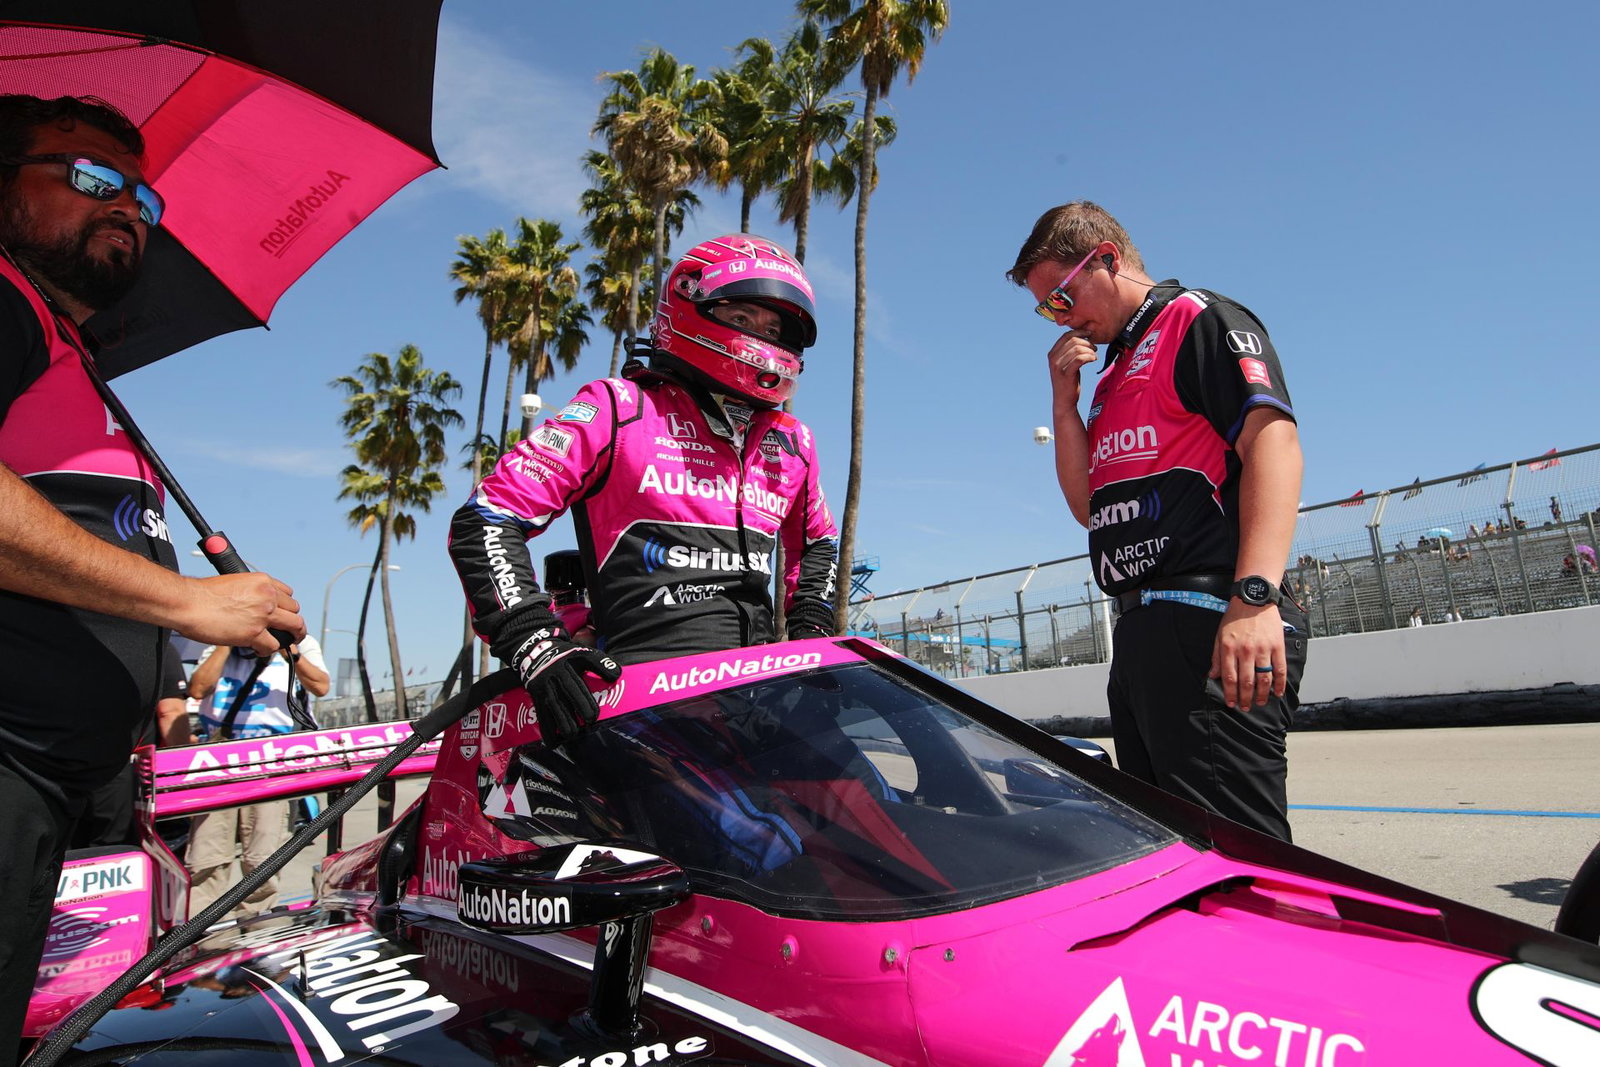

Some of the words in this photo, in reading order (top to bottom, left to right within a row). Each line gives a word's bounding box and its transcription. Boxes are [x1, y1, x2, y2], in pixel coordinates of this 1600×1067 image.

[740, 350, 791, 375] HONDA
[548, 432, 567, 450] PNK
[655, 436, 716, 454] HONDA
[522, 459, 554, 479] ARCTIC
[657, 453, 691, 463] RICHARD
[692, 457, 716, 468] MILLE
[523, 467, 548, 484] WOLF
[638, 464, 789, 518] AutoNation
[649, 652, 822, 695] AutoNation
[82, 865, 132, 894] PNK
[457, 883, 572, 926] AutoNation
[1149, 995, 1366, 1067] ARCTIC
